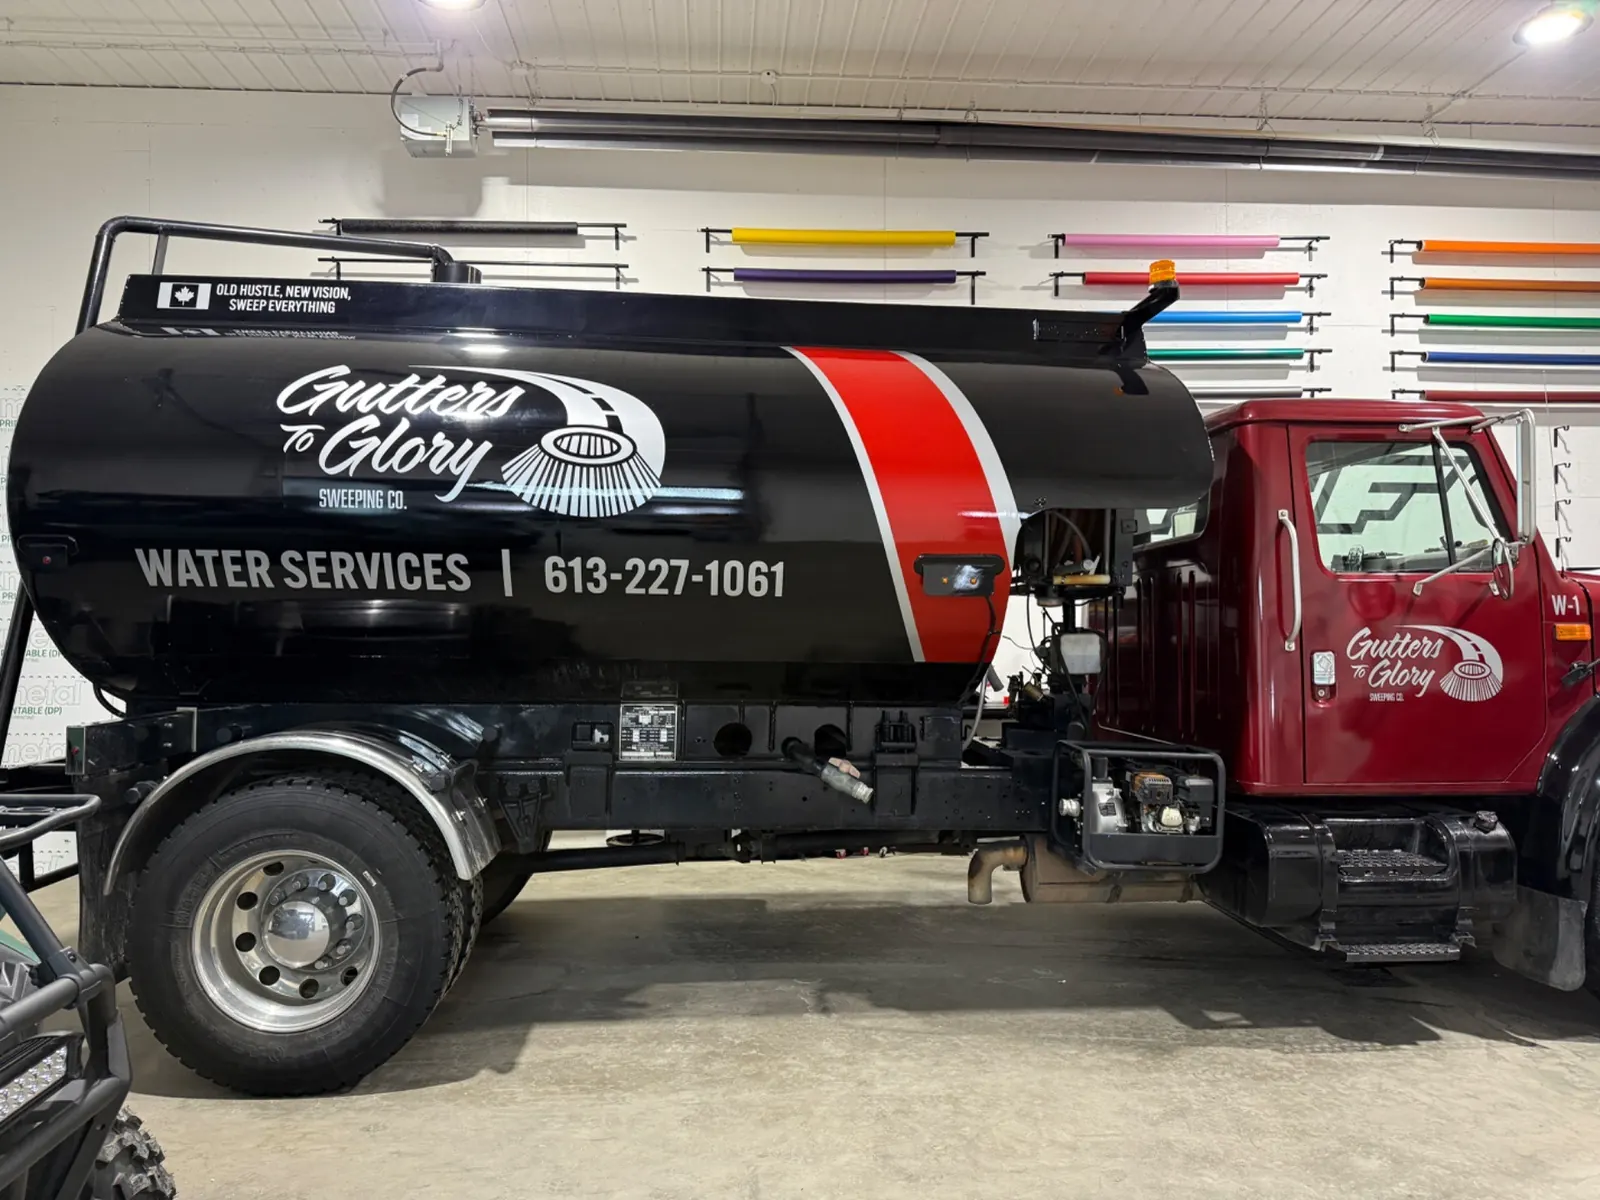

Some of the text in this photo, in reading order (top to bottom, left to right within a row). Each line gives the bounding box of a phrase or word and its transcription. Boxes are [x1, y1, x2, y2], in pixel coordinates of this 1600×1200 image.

[216, 283, 352, 301] OLD HUSTLE, NEW VISION,
[229, 298, 336, 314] SWEEP EVERYTHING
[276, 364, 526, 418] Gutters
[318, 414, 493, 503] Glory
[318, 488, 408, 510] SWEEPING CO.
[134, 548, 275, 588] WATER
[280, 550, 472, 592] SERVICES
[544, 555, 785, 597] 613-227-1061
[1551, 594, 1581, 616] W-1
[1346, 626, 1444, 661] Gutters
[1367, 658, 1436, 698] Glory
[1369, 692, 1396, 702] SWEEPING
